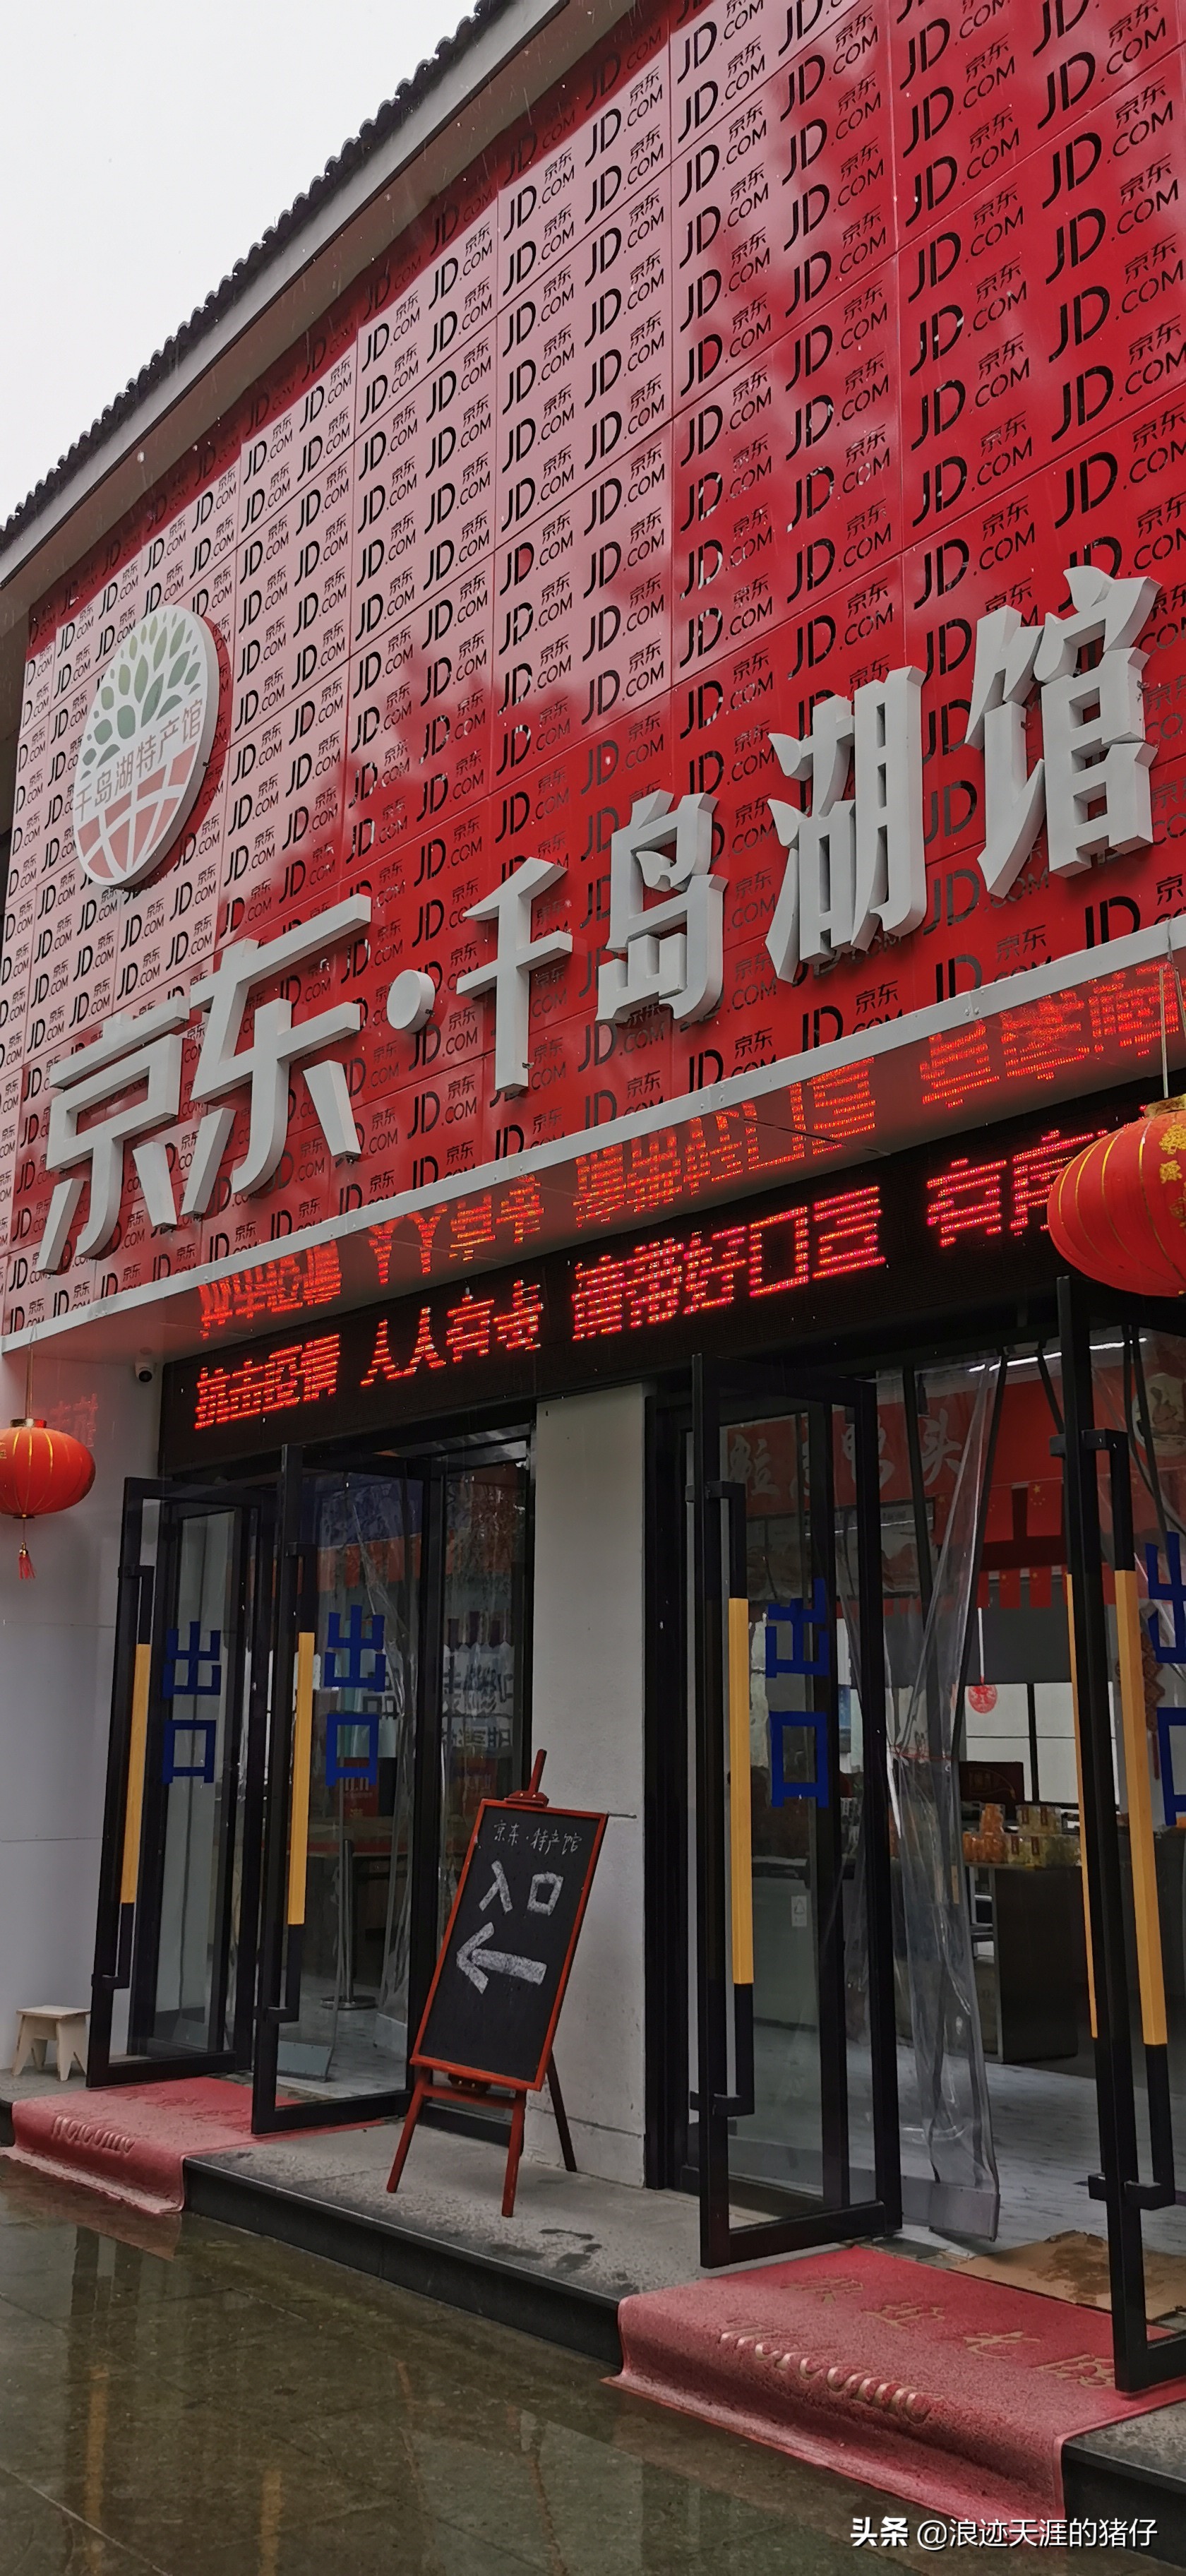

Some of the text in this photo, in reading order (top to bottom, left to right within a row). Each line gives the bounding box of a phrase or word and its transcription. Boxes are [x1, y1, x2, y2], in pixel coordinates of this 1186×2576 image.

[835, 6, 873, 52] 京东
[1108, 3, 1159, 47] 京东
[966, 33, 1009, 83] 京东
[630, 66, 659, 106] 京东
[838, 70, 876, 116] 京东
[1115, 76, 1166, 129] 京东
[729, 100, 762, 143] 京东
[630, 124, 660, 164] 京东
[545, 147, 572, 184] 京东
[1120, 154, 1171, 205] 京东
[973, 182, 1017, 229] 京东
[842, 205, 881, 249] 京东
[731, 227, 766, 268] 京东
[1125, 234, 1175, 284] 京东
[544, 264, 571, 301] 京东
[630, 248, 661, 285] 京东
[395, 290, 418, 323] 京东
[465, 276, 490, 311] 京东
[845, 351, 884, 395] 京东
[978, 333, 1024, 380] 京东
[544, 383, 571, 419] 京东
[630, 374, 661, 412] 京东
[733, 364, 767, 406] 京东
[328, 406, 349, 436] 京东
[393, 400, 415, 433] 京东
[463, 394, 489, 427] 京东
[325, 513, 347, 543] 京东
[391, 511, 414, 541] 京东
[462, 510, 487, 542] 京东
[542, 510, 570, 544] 京东
[630, 507, 661, 544] 京东
[847, 498, 886, 540] 京东
[982, 495, 1029, 541] 京东
[323, 619, 344, 648] 京东
[388, 625, 411, 655] 京东
[459, 629, 484, 660] 京东
[541, 634, 569, 667] 京东
[629, 639, 661, 674] 京东
[733, 648, 769, 684] 京东
[264, 667, 283, 693] 京东
[261, 722, 282, 747] 京东
[318, 730, 340, 757] 京东
[75, 698, 202, 822] 千岛湖特产馆
[455, 749, 481, 775] 京东
[537, 765, 565, 796] 京东
[254, 825, 275, 850] 京东
[312, 839, 335, 863] 京东
[448, 1074, 474, 1100] 京东
[162, 1621, 222, 1784] 出口
[324, 1604, 386, 1787] 出口
[765, 1577, 829, 1808] 出口
[479, 1859, 564, 1916] 入口
